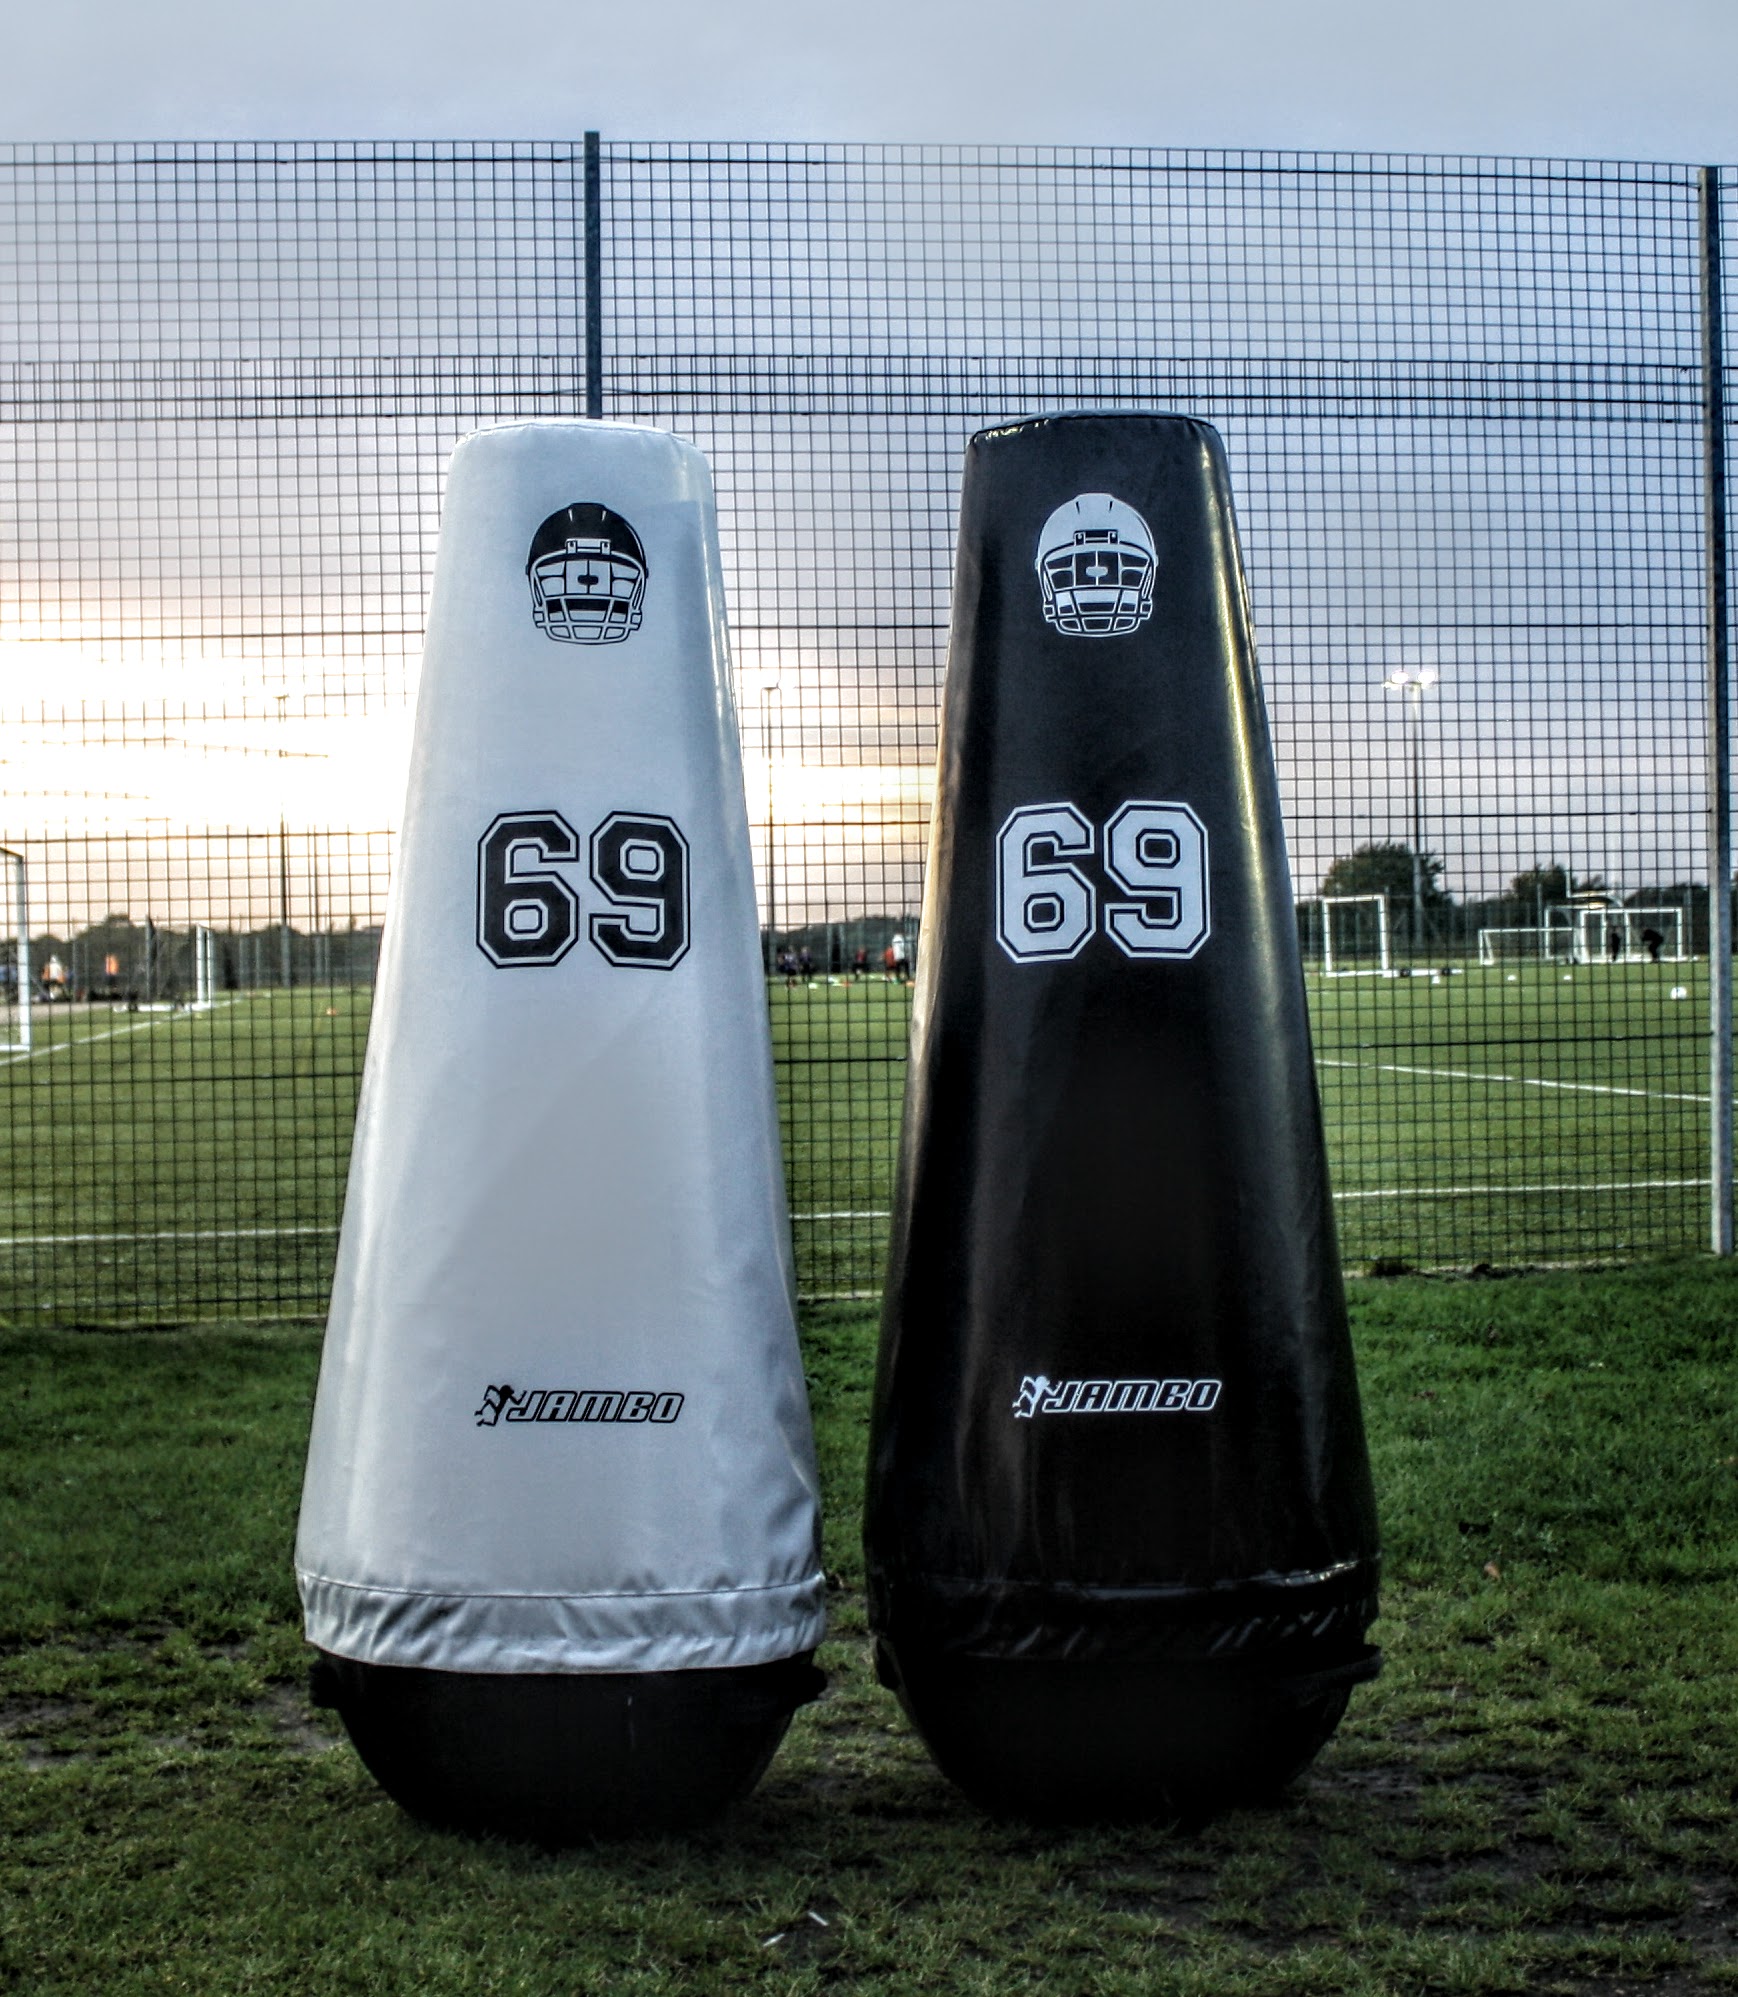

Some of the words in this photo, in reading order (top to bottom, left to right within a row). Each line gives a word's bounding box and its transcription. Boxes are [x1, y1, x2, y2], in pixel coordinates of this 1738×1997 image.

[476, 810, 690, 971] 69
[996, 800, 1211, 964] 69
[505, 1390, 685, 1424] JAMBO
[1042, 1379, 1222, 1413] JAMBO
